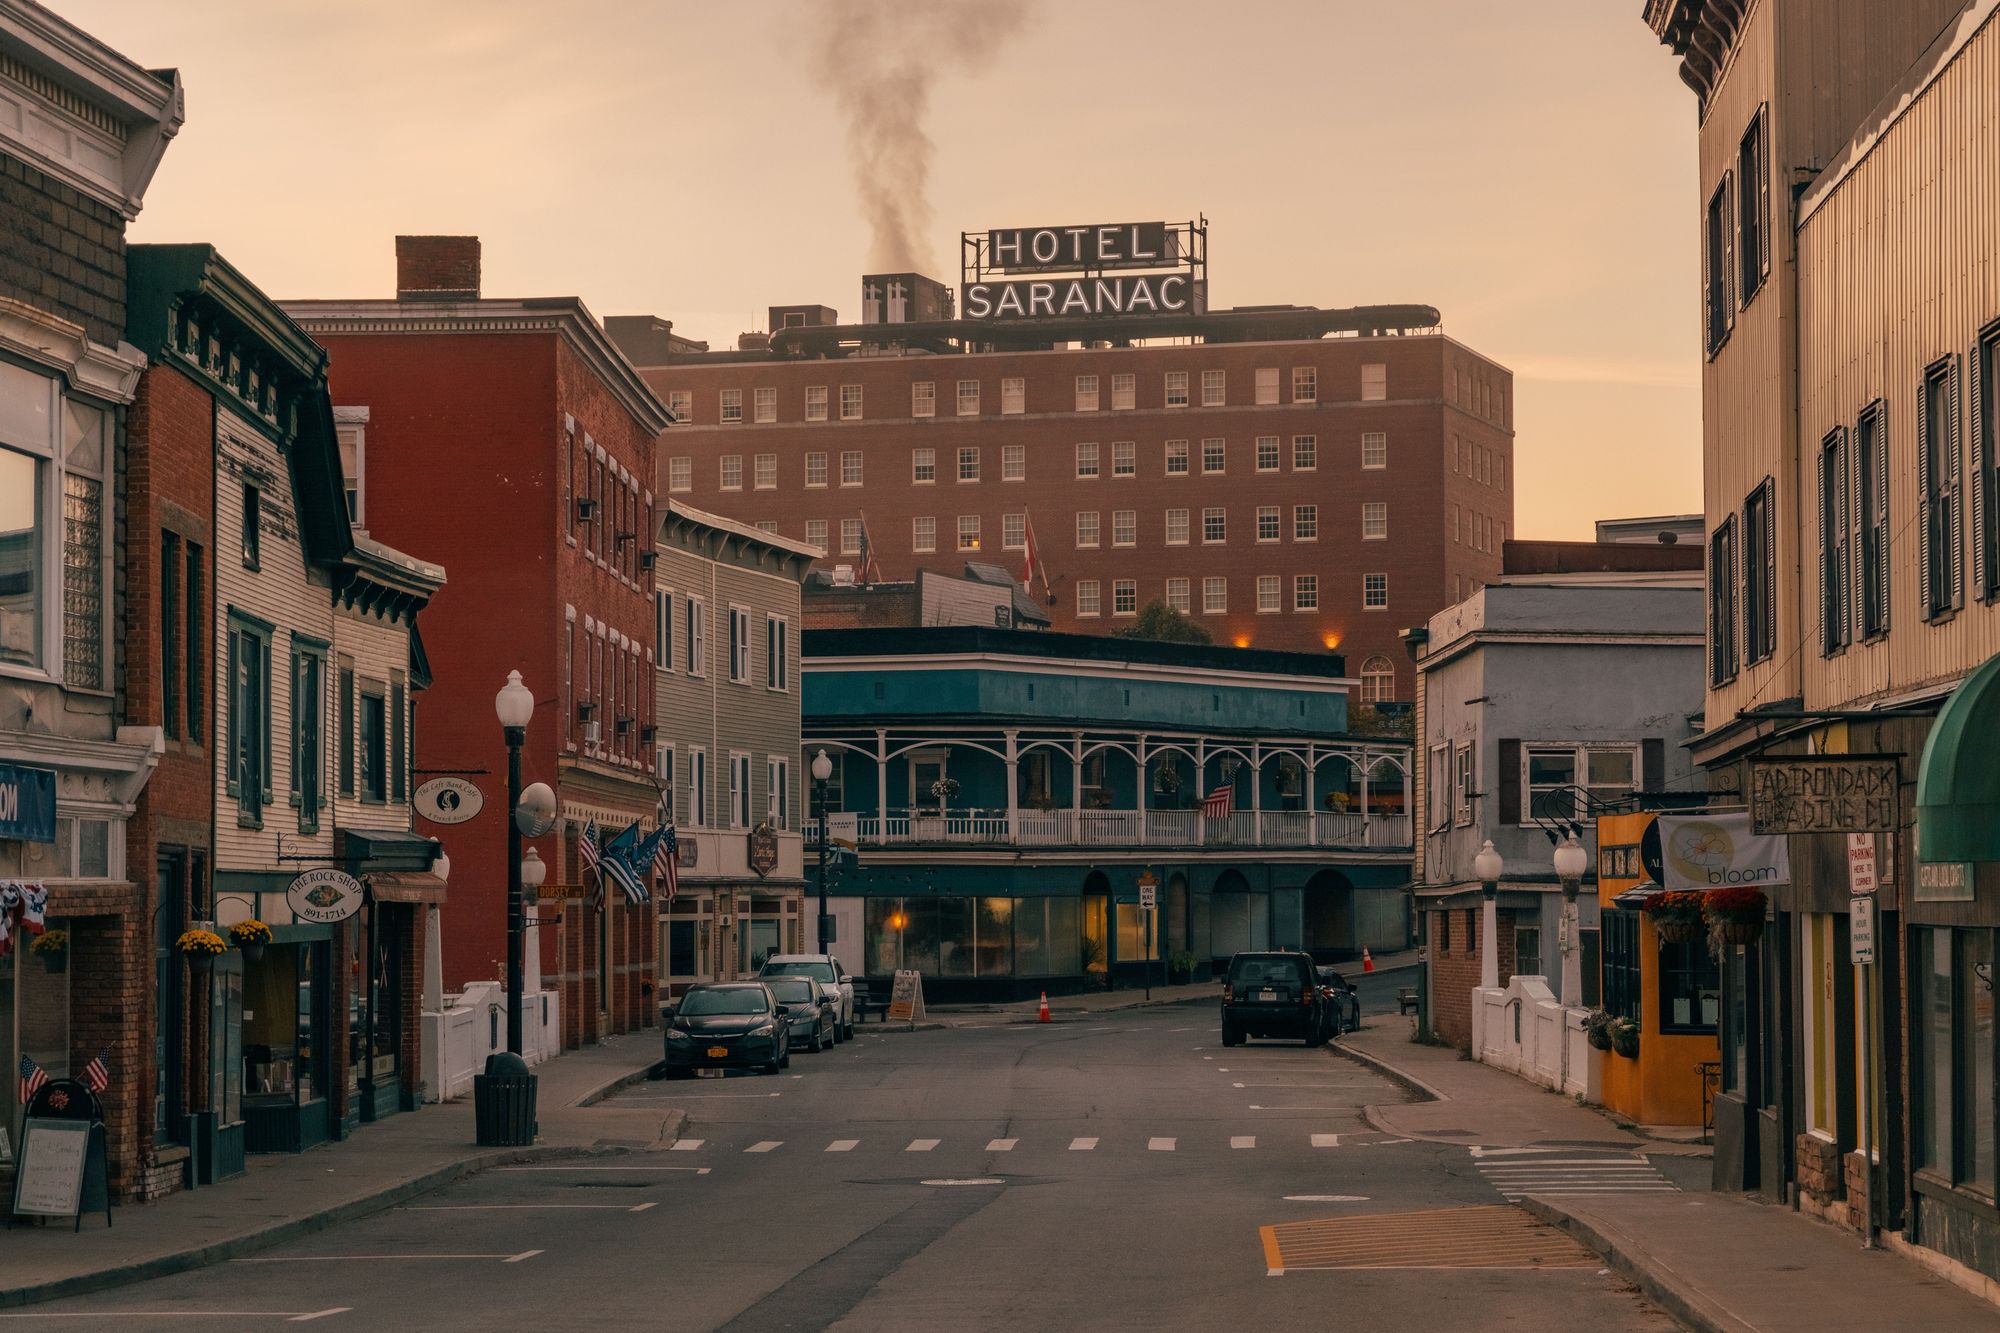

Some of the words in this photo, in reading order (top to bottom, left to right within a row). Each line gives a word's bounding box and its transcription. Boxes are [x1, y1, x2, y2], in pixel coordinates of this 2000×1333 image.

[996, 225, 1157, 264] HOTEL
[967, 276, 1186, 318] SARANAC
[1761, 766, 1894, 797] ADIRONDACK
[1757, 799, 1854, 829] TRADING
[1866, 798, 1892, 829] CO
[1857, 834, 1865, 845] NO
[1850, 847, 1873, 860] PARKING
[1854, 864, 1865, 873] HERE
[1866, 864, 1872, 872] TO
[1707, 866, 1778, 884] bloom
[291, 876, 309, 893] THE
[310, 872, 337, 882] ROCK
[338, 875, 361, 894] SHOP
[1856, 877, 1871, 886] CORNER
[540, 887, 569, 897] DORSEY
[304, 908, 346, 919] 891-1714
[1857, 905, 1865, 914] TWO
[1856, 919, 1867, 928] HOUR
[1854, 932, 1870, 942] PARKING
